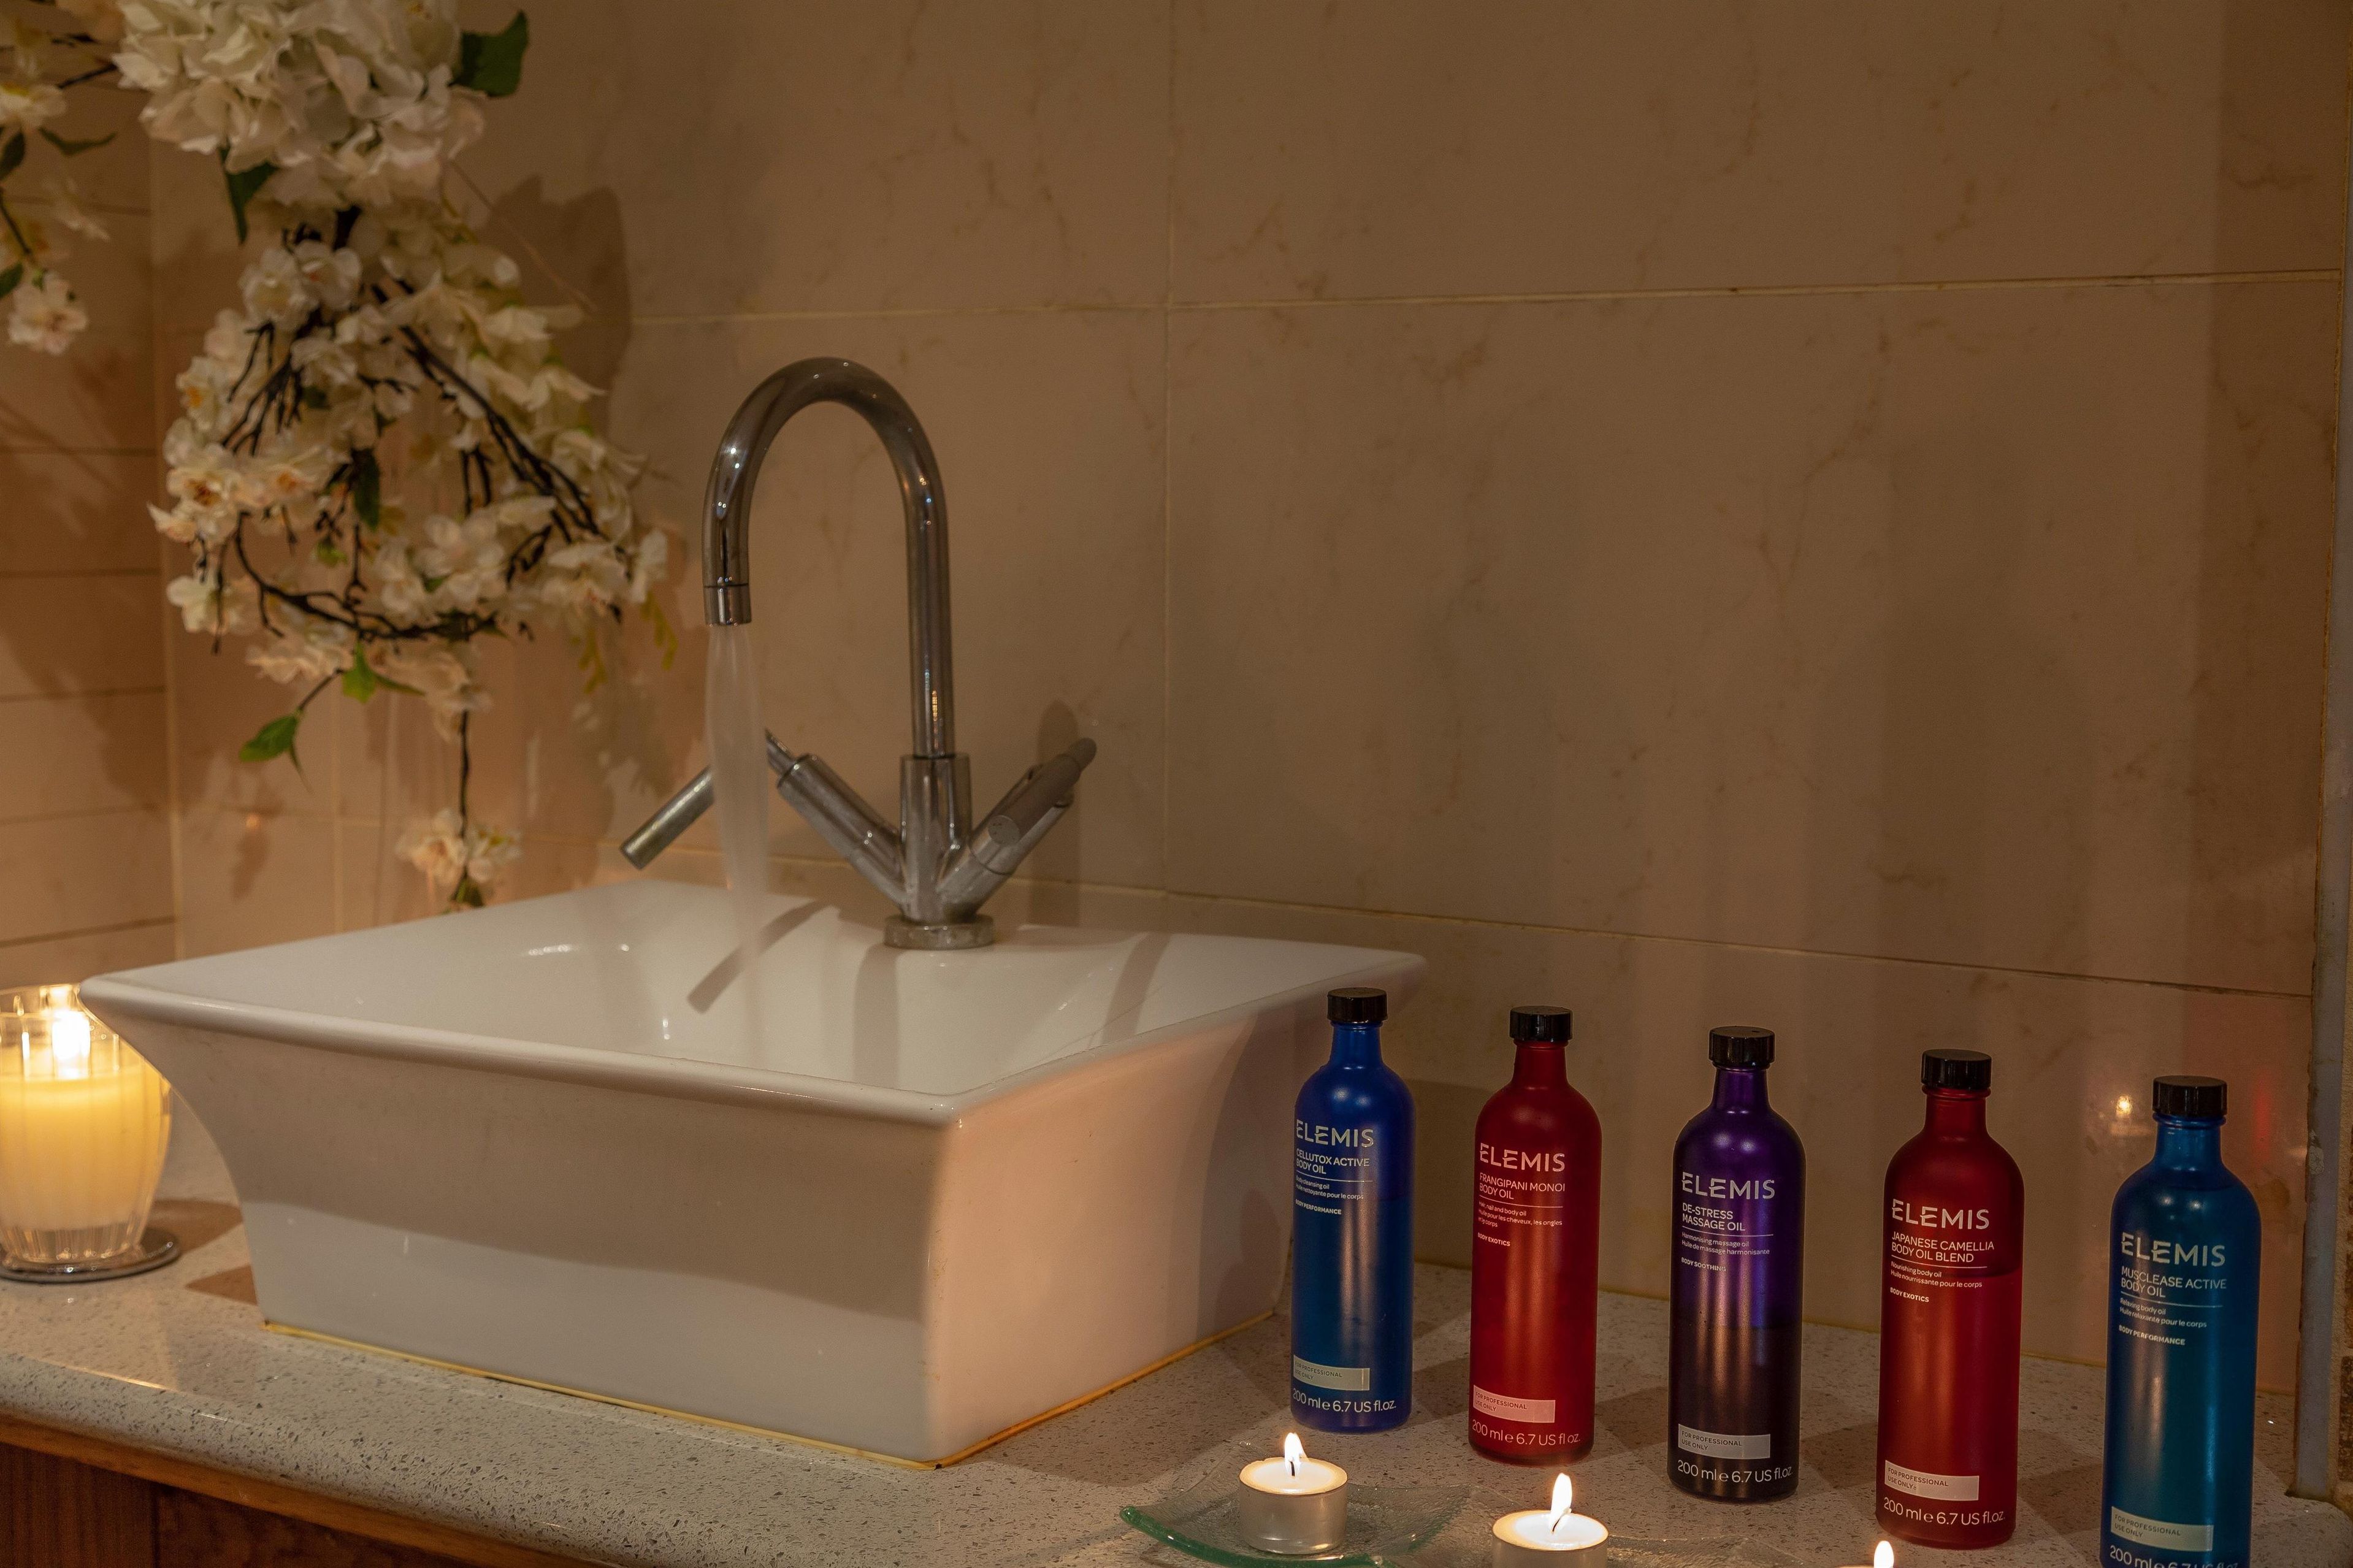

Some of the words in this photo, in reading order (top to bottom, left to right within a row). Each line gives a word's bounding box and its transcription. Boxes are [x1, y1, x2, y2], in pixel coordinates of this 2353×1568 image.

[1296, 1119, 1374, 1147] ELEMIS
[1296, 1148, 1332, 1165] CELLUTOX
[1333, 1157, 1369, 1166] ACTIVE
[1480, 1142, 1565, 1172] ELEMIS
[1296, 1158, 1311, 1171] BODY
[1312, 1164, 1326, 1174] OIL
[1480, 1172, 1527, 1190] FRANGIPANI
[1530, 1182, 1565, 1191] MONOI
[1682, 1171, 1775, 1199] ELEMIS
[1479, 1182, 1498, 1196] BODY
[1499, 1189, 1514, 1199] OIL
[1304, 1203, 1342, 1215] PERFORMANCE
[1504, 1207, 1518, 1216] body
[1682, 1203, 1734, 1220] DE-STRESS
[1892, 1198, 1989, 1230] ELEMIS
[1485, 1219, 1498, 1228] corps
[1507, 1217, 1532, 1225] cheveux,
[1682, 1213, 1724, 1230] MASSAGE
[1727, 1222, 1745, 1231] OIL
[1488, 1237, 1510, 1246] EXOTICS
[1682, 1232, 1712, 1245] Harmonising
[1892, 1231, 1938, 1249] JAPANESE
[1940, 1241, 1994, 1251] CAMELLIA
[1700, 1245, 1726, 1255] massage
[1892, 1242, 1915, 1256] BODY
[1916, 1249, 1933, 1260] OIL
[1935, 1252, 1974, 1263] BLEND
[2121, 1232, 2225, 1267] ELEMIS
[1681, 1257, 1694, 1266] BODY
[1694, 1261, 1726, 1272] SOOTHING
[1891, 1261, 1916, 1274] Nourishing
[1917, 1268, 1933, 1279] body
[1891, 1270, 1901, 1279] Huile
[1902, 1274, 1939, 1286] nourrissante
[2122, 1266, 2183, 1288] MUSCLEASE
[2185, 1279, 2227, 1290] ACTIVE
[1890, 1287, 1902, 1296] BODY
[1903, 1292, 1929, 1302] EXOTICS
[2121, 1278, 2146, 1293] BODY
[2147, 1286, 2166, 1298] OIL
[2121, 1298, 2141, 1310] Relaxing
[2141, 1304, 2157, 1315] body
[2119, 1325, 2133, 1335] BODY
[2133, 1330, 2186, 1345] PERFORMANCE
[1302, 1364, 1342, 1377] PROFESSIONAL
[1293, 1388, 1306, 1404] 200
[1308, 1398, 1320, 1409] ml
[1333, 1400, 1351, 1412] 6.7
[1354, 1401, 1371, 1413] US
[1483, 1395, 1527, 1410] PROFESSIONAL
[1472, 1419, 1488, 1436] 200
[1490, 1429, 1503, 1441] ml
[1517, 1433, 1536, 1445] 6.7
[1539, 1434, 1556, 1445] US
[1693, 1434, 1742, 1446] PROFESSIONAL
[1692, 1442, 1708, 1451] ONLY
[1678, 1459, 1699, 1477] 200
[1701, 1469, 1716, 1480] ml
[1732, 1471, 1752, 1483] 6.7
[1755, 1470, 1772, 1482] US
[1888, 1467, 1897, 1476] FOR
[1898, 1472, 1949, 1486] PROFESSIONAL
[1888, 1475, 1897, 1484] USE
[1884, 1497, 1903, 1515] 200
[1906, 1509, 1921, 1521] ml
[1937, 1512, 1958, 1525] 6.7
[1961, 1513, 1980, 1525] US
[2126, 1520, 2181, 1536] PROFESSIONAL
[2110, 1545, 2132, 1565] 200
